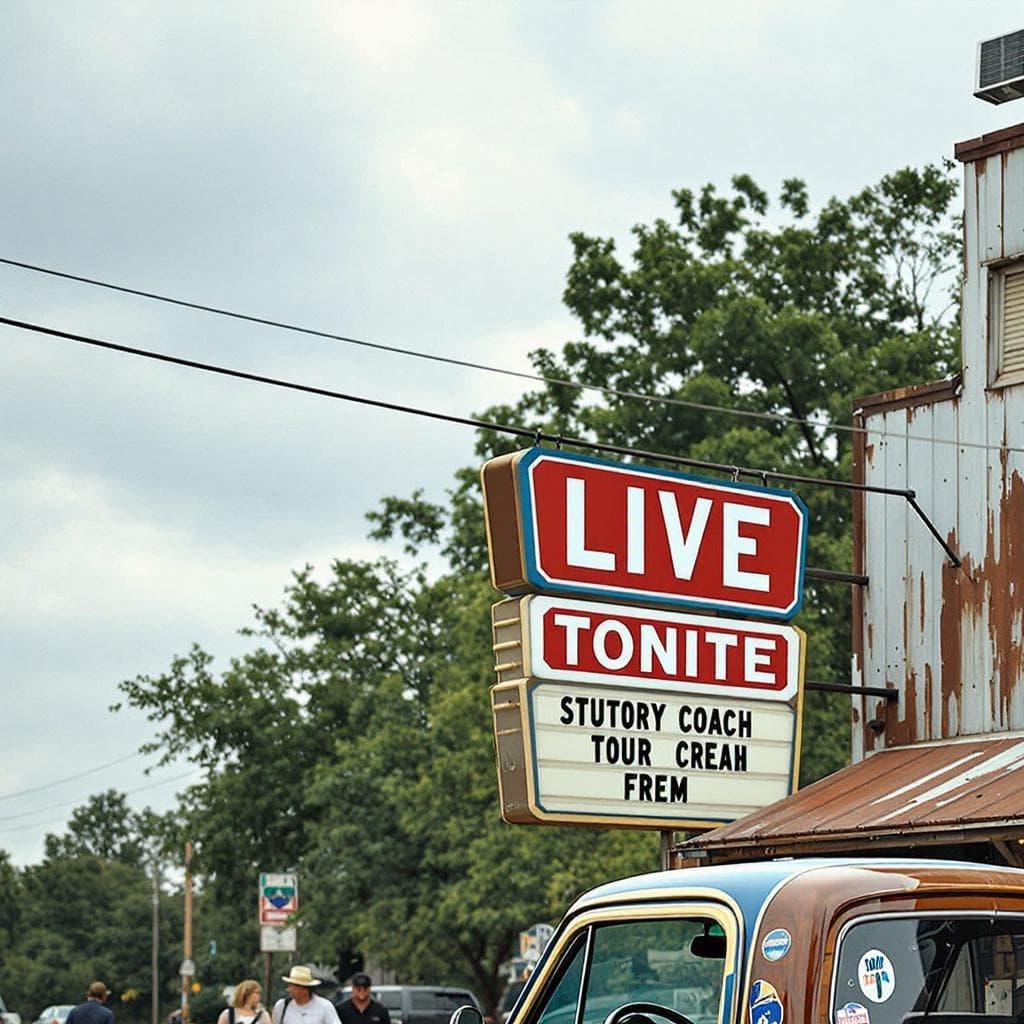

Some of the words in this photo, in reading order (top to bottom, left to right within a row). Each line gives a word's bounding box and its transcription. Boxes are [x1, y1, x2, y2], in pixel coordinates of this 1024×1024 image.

[566, 476, 771, 592] LIVE
[553, 613, 777, 685] TONITE
[560, 695, 666, 732] STUTORY
[678, 705, 752, 738] COACH
[591, 734, 652, 767] TOUR
[675, 740, 748, 772] CREAH
[624, 773, 689, 804] FREM
